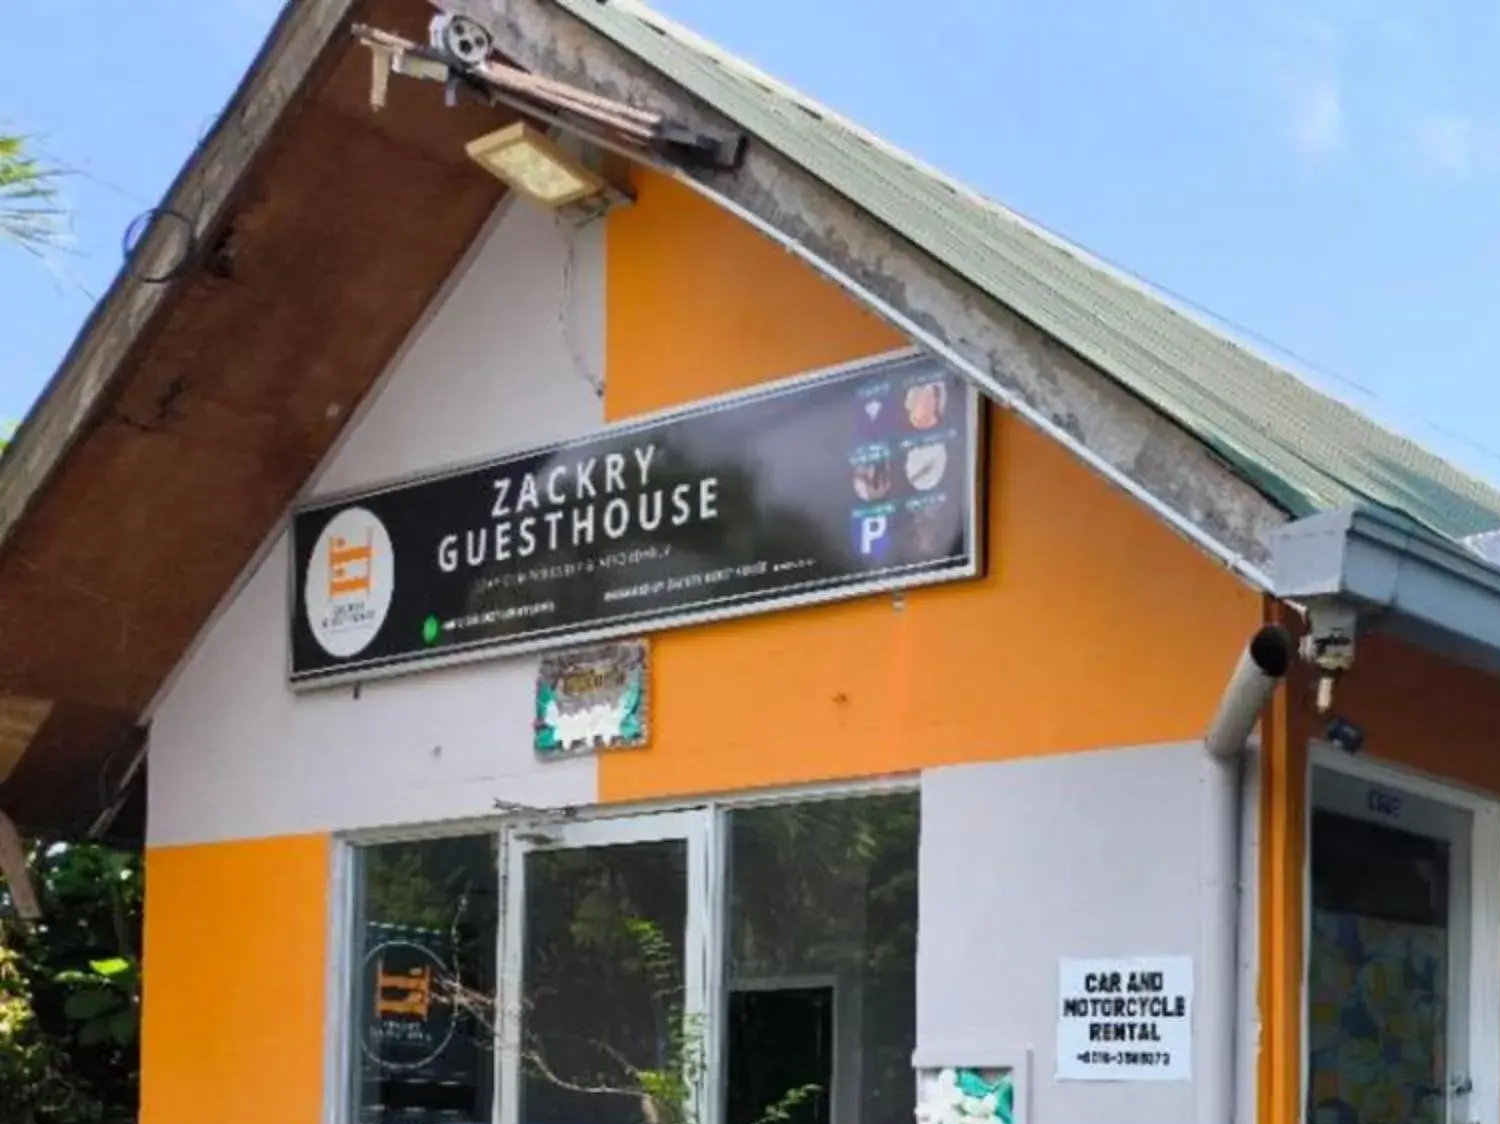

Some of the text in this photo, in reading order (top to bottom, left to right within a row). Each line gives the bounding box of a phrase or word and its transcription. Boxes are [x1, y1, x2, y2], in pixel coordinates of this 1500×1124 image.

[491, 444, 655, 517] ZACKRY
[437, 478, 718, 572] GUESTHOUSE
[862, 516, 887, 554] P
[1085, 971, 1163, 993] CAR AND
[1063, 996, 1185, 1017] MOTORCYCLE
[1089, 1023, 1161, 1041] RENTAL
